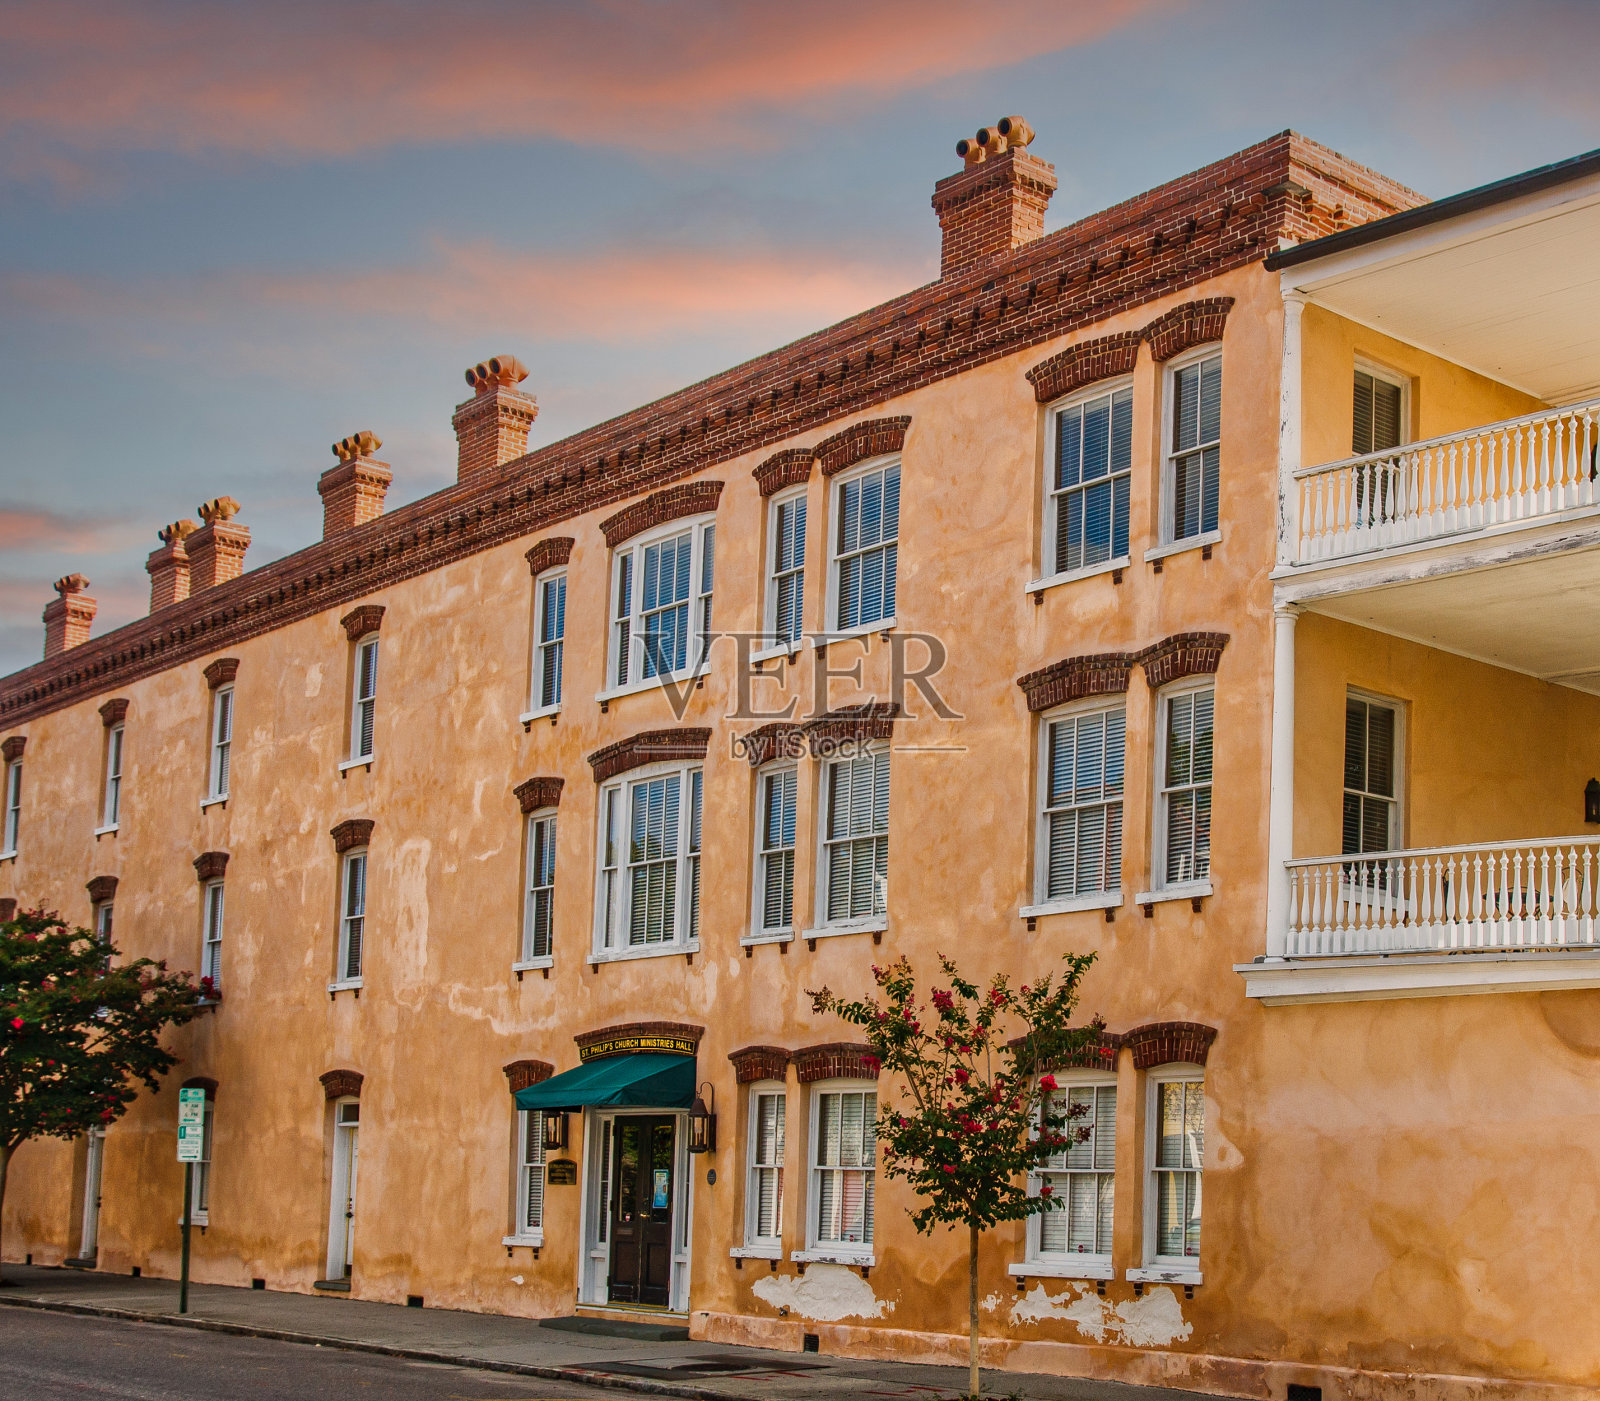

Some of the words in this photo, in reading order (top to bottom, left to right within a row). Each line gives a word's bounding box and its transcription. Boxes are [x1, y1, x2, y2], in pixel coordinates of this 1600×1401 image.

[590, 1042, 613, 1054] PHILIP'S
[614, 1039, 639, 1048] CHURCH
[640, 1039, 674, 1048] MINISTRIES
[675, 1040, 692, 1051] HALL
